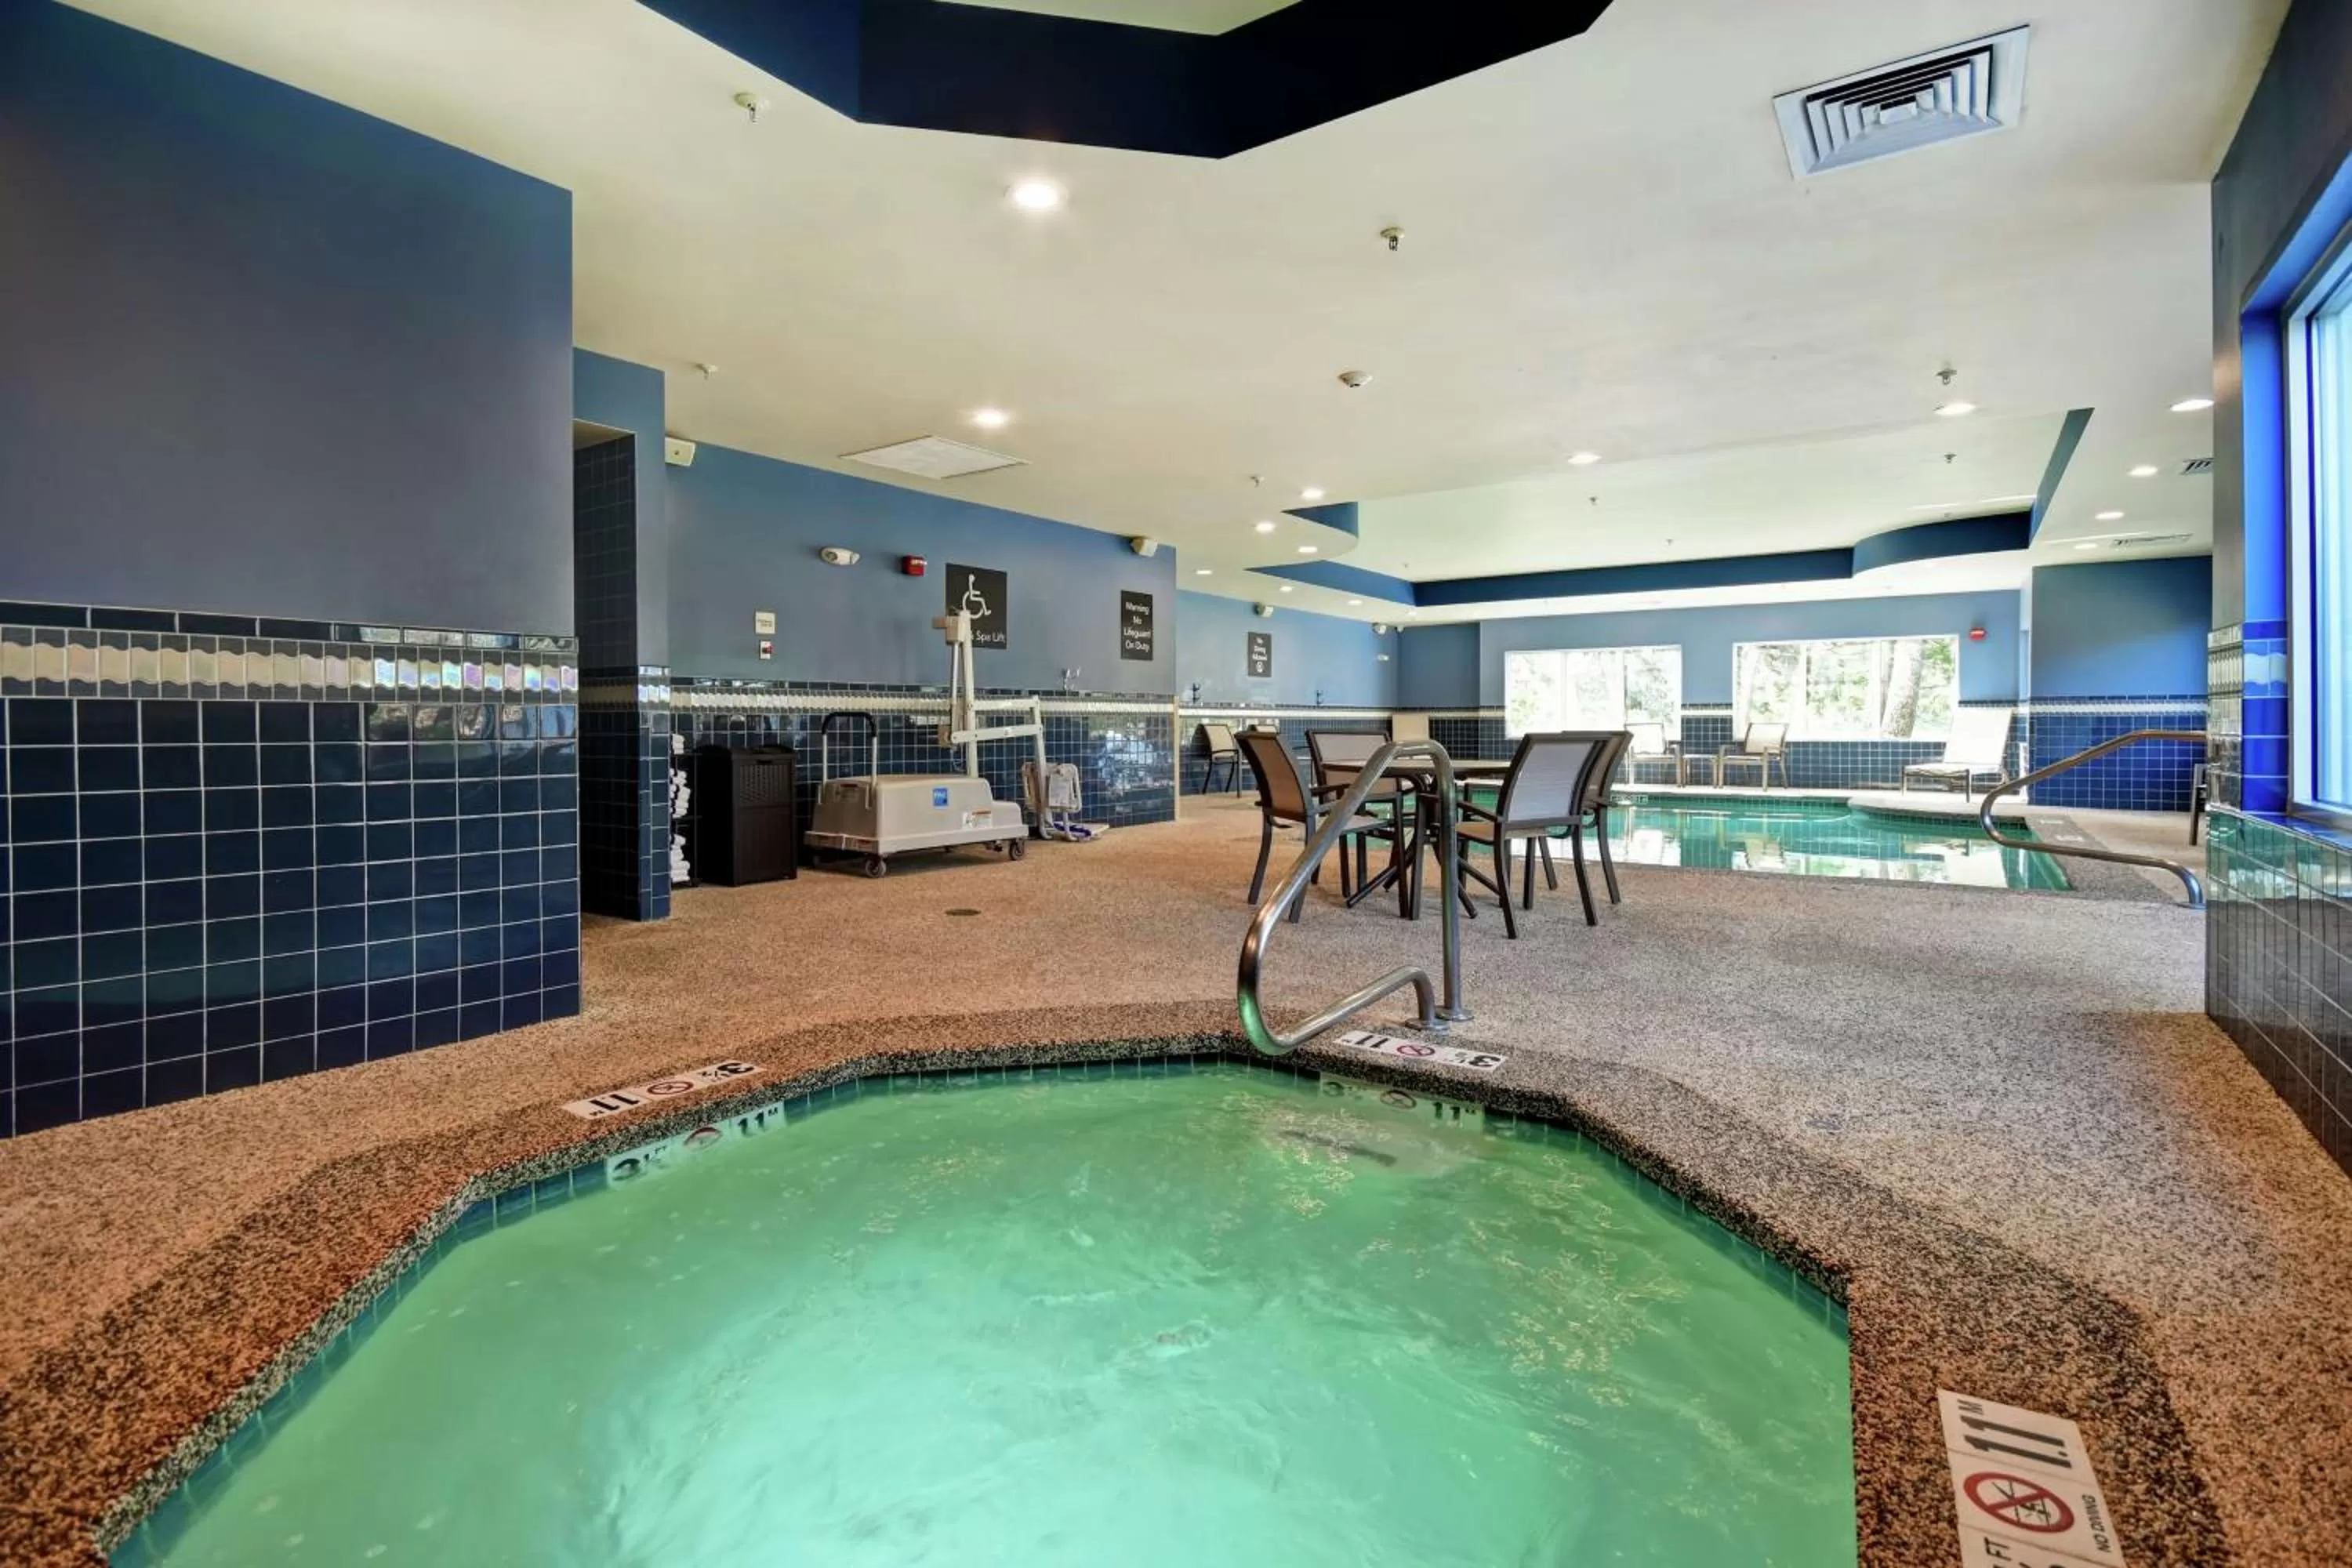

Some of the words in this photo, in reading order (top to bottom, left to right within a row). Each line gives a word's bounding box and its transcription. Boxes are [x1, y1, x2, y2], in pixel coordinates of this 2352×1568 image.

[2082, 1494, 2105, 1534] DIVING
[1984, 1536, 2013, 1562] FT
[2092, 1534, 2111, 1553] NO
